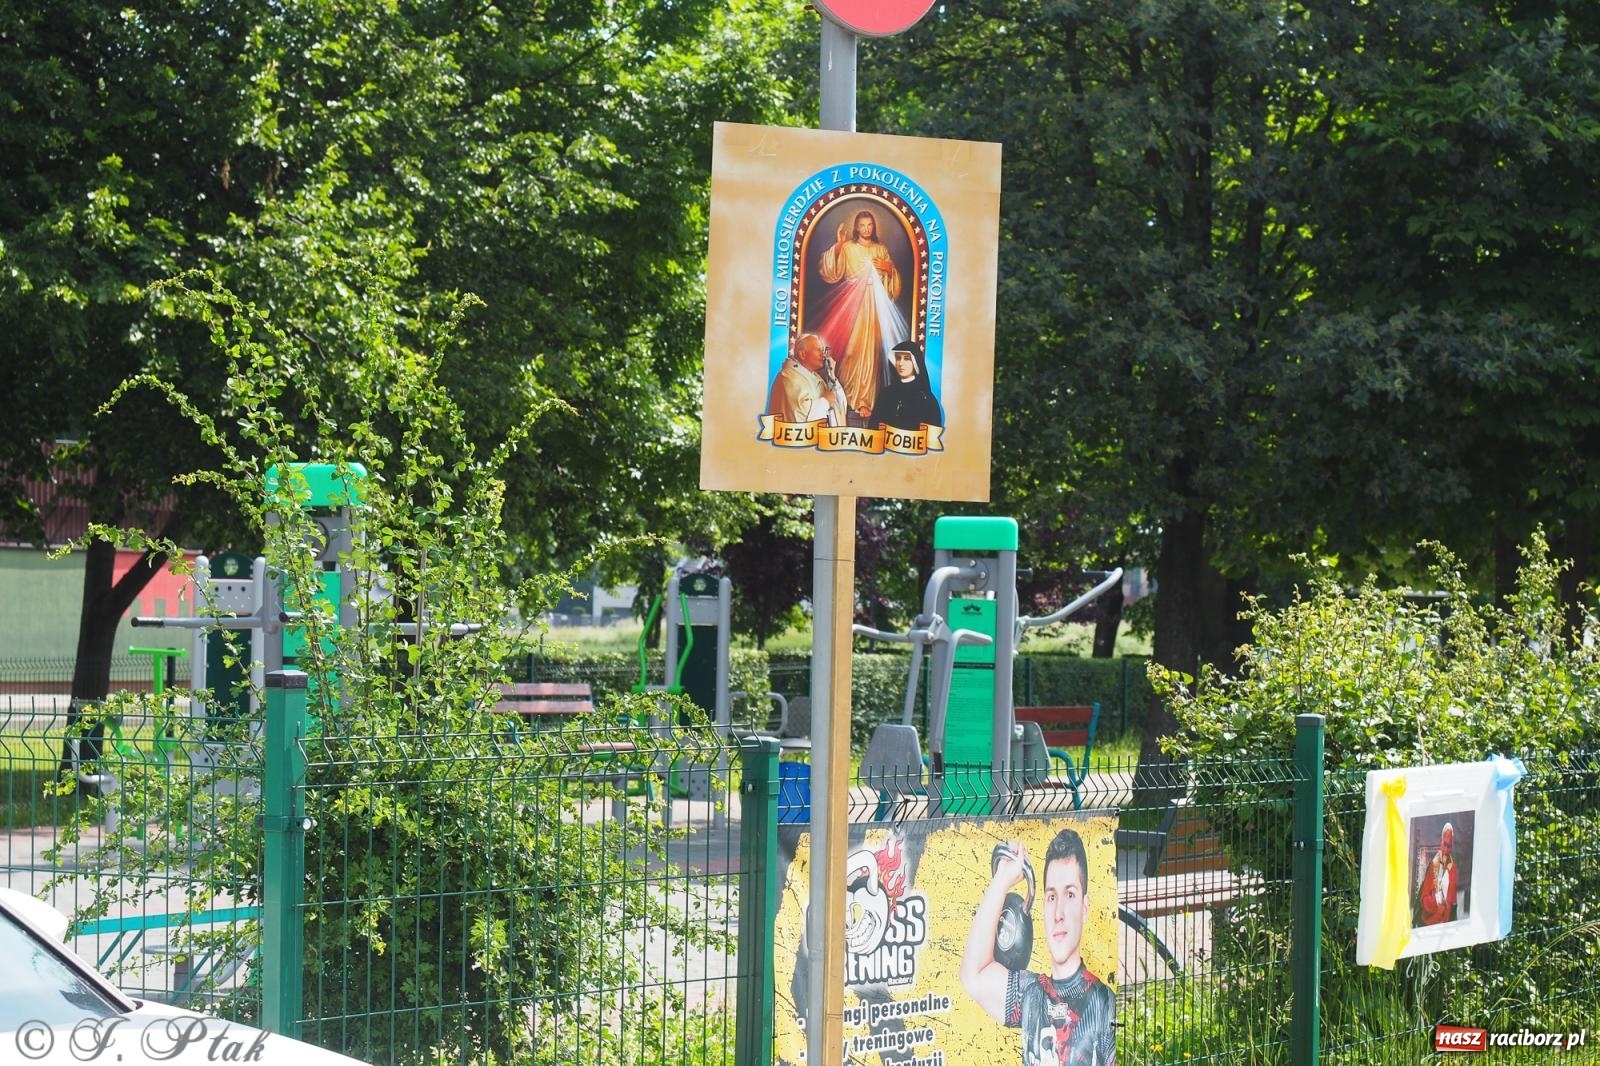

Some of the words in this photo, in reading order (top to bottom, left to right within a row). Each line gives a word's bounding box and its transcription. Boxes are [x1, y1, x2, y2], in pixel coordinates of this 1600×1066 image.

[832, 170, 842, 183] Z
[850, 166, 929, 214] POKOLENIA
[777, 178, 825, 280] MIŁOSIERDZIE
[926, 219, 942, 243] NA
[774, 287, 788, 328] JEGO
[929, 251, 944, 337] POKOLENIE
[776, 427, 815, 442] JEZU
[828, 432, 873, 448] UFAM
[885, 430, 924, 450] TOBIE
[871, 994, 950, 1023] personalne
[853, 1028, 934, 1052] treningowe
